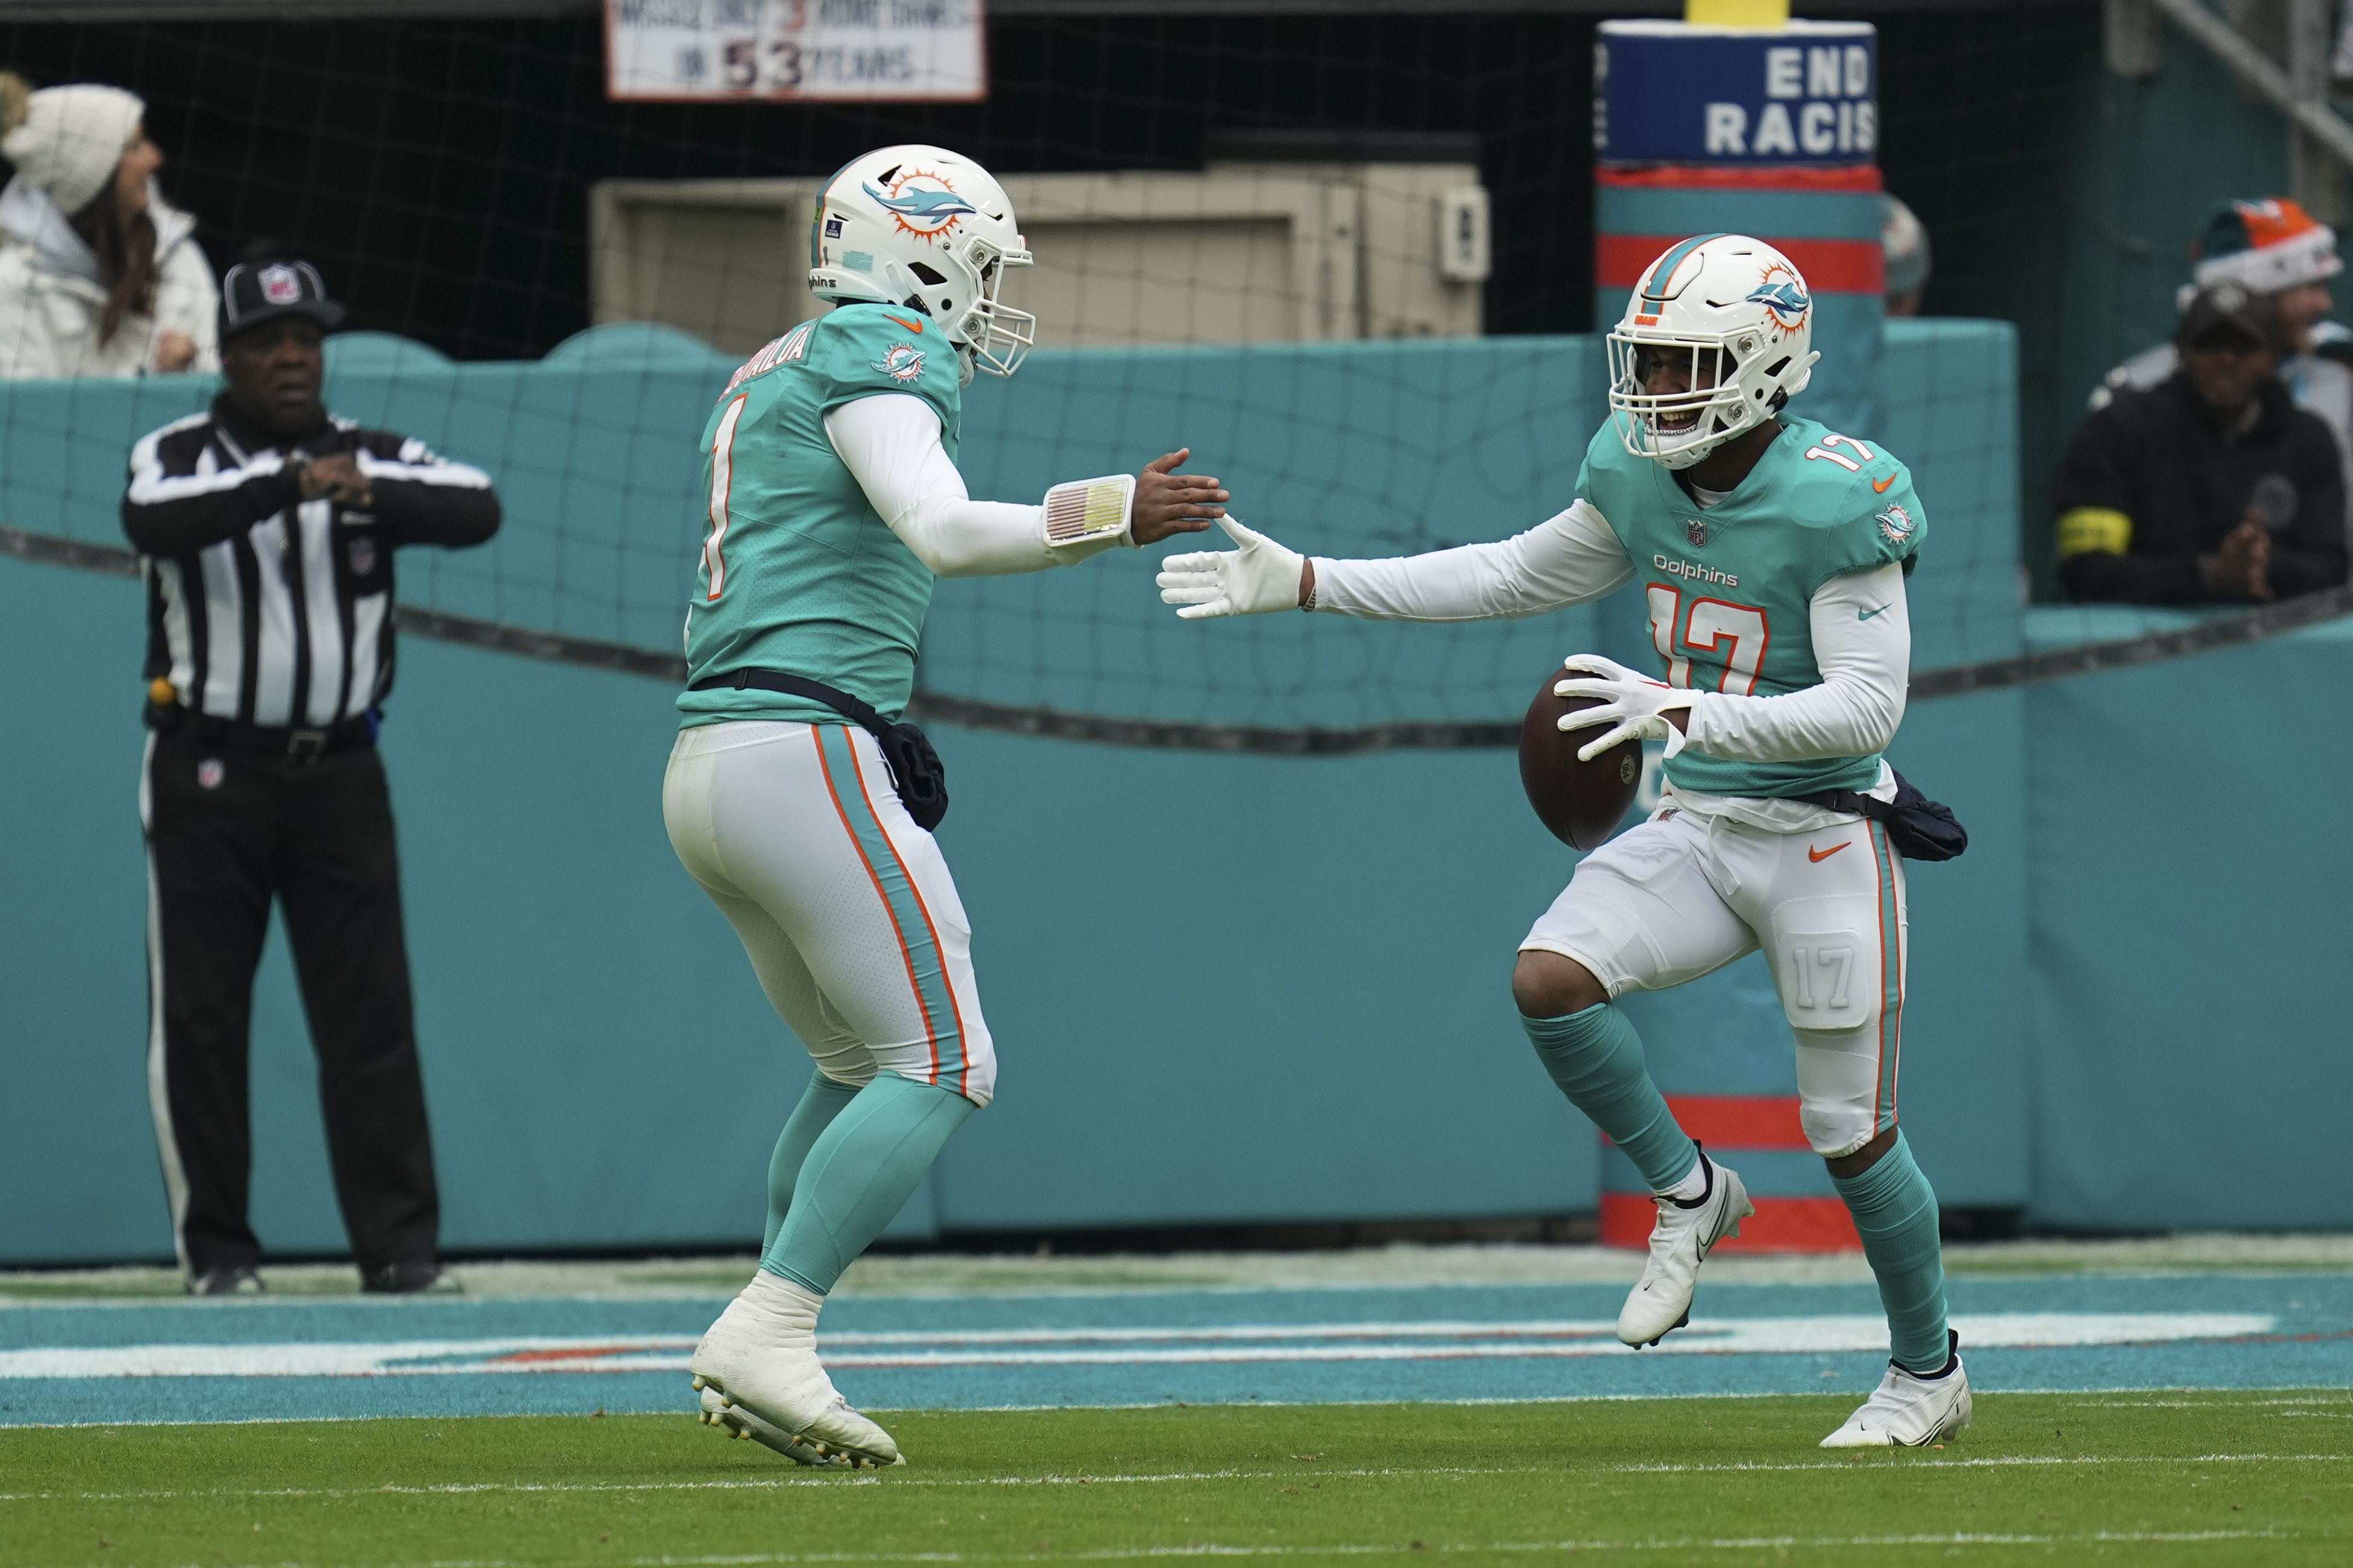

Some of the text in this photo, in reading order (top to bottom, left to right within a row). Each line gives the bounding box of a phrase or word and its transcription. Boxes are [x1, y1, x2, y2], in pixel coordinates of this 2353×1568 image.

[724, 40, 803, 88] 53
[1766, 46, 1869, 99] END
[1805, 434, 1875, 472] 17
[706, 392, 749, 601] 1
[1689, 531, 1704, 543] NFL
[1654, 554, 1739, 588] Dolphins
[1645, 582, 1770, 696] 17
[1793, 946, 1854, 1009] 17
